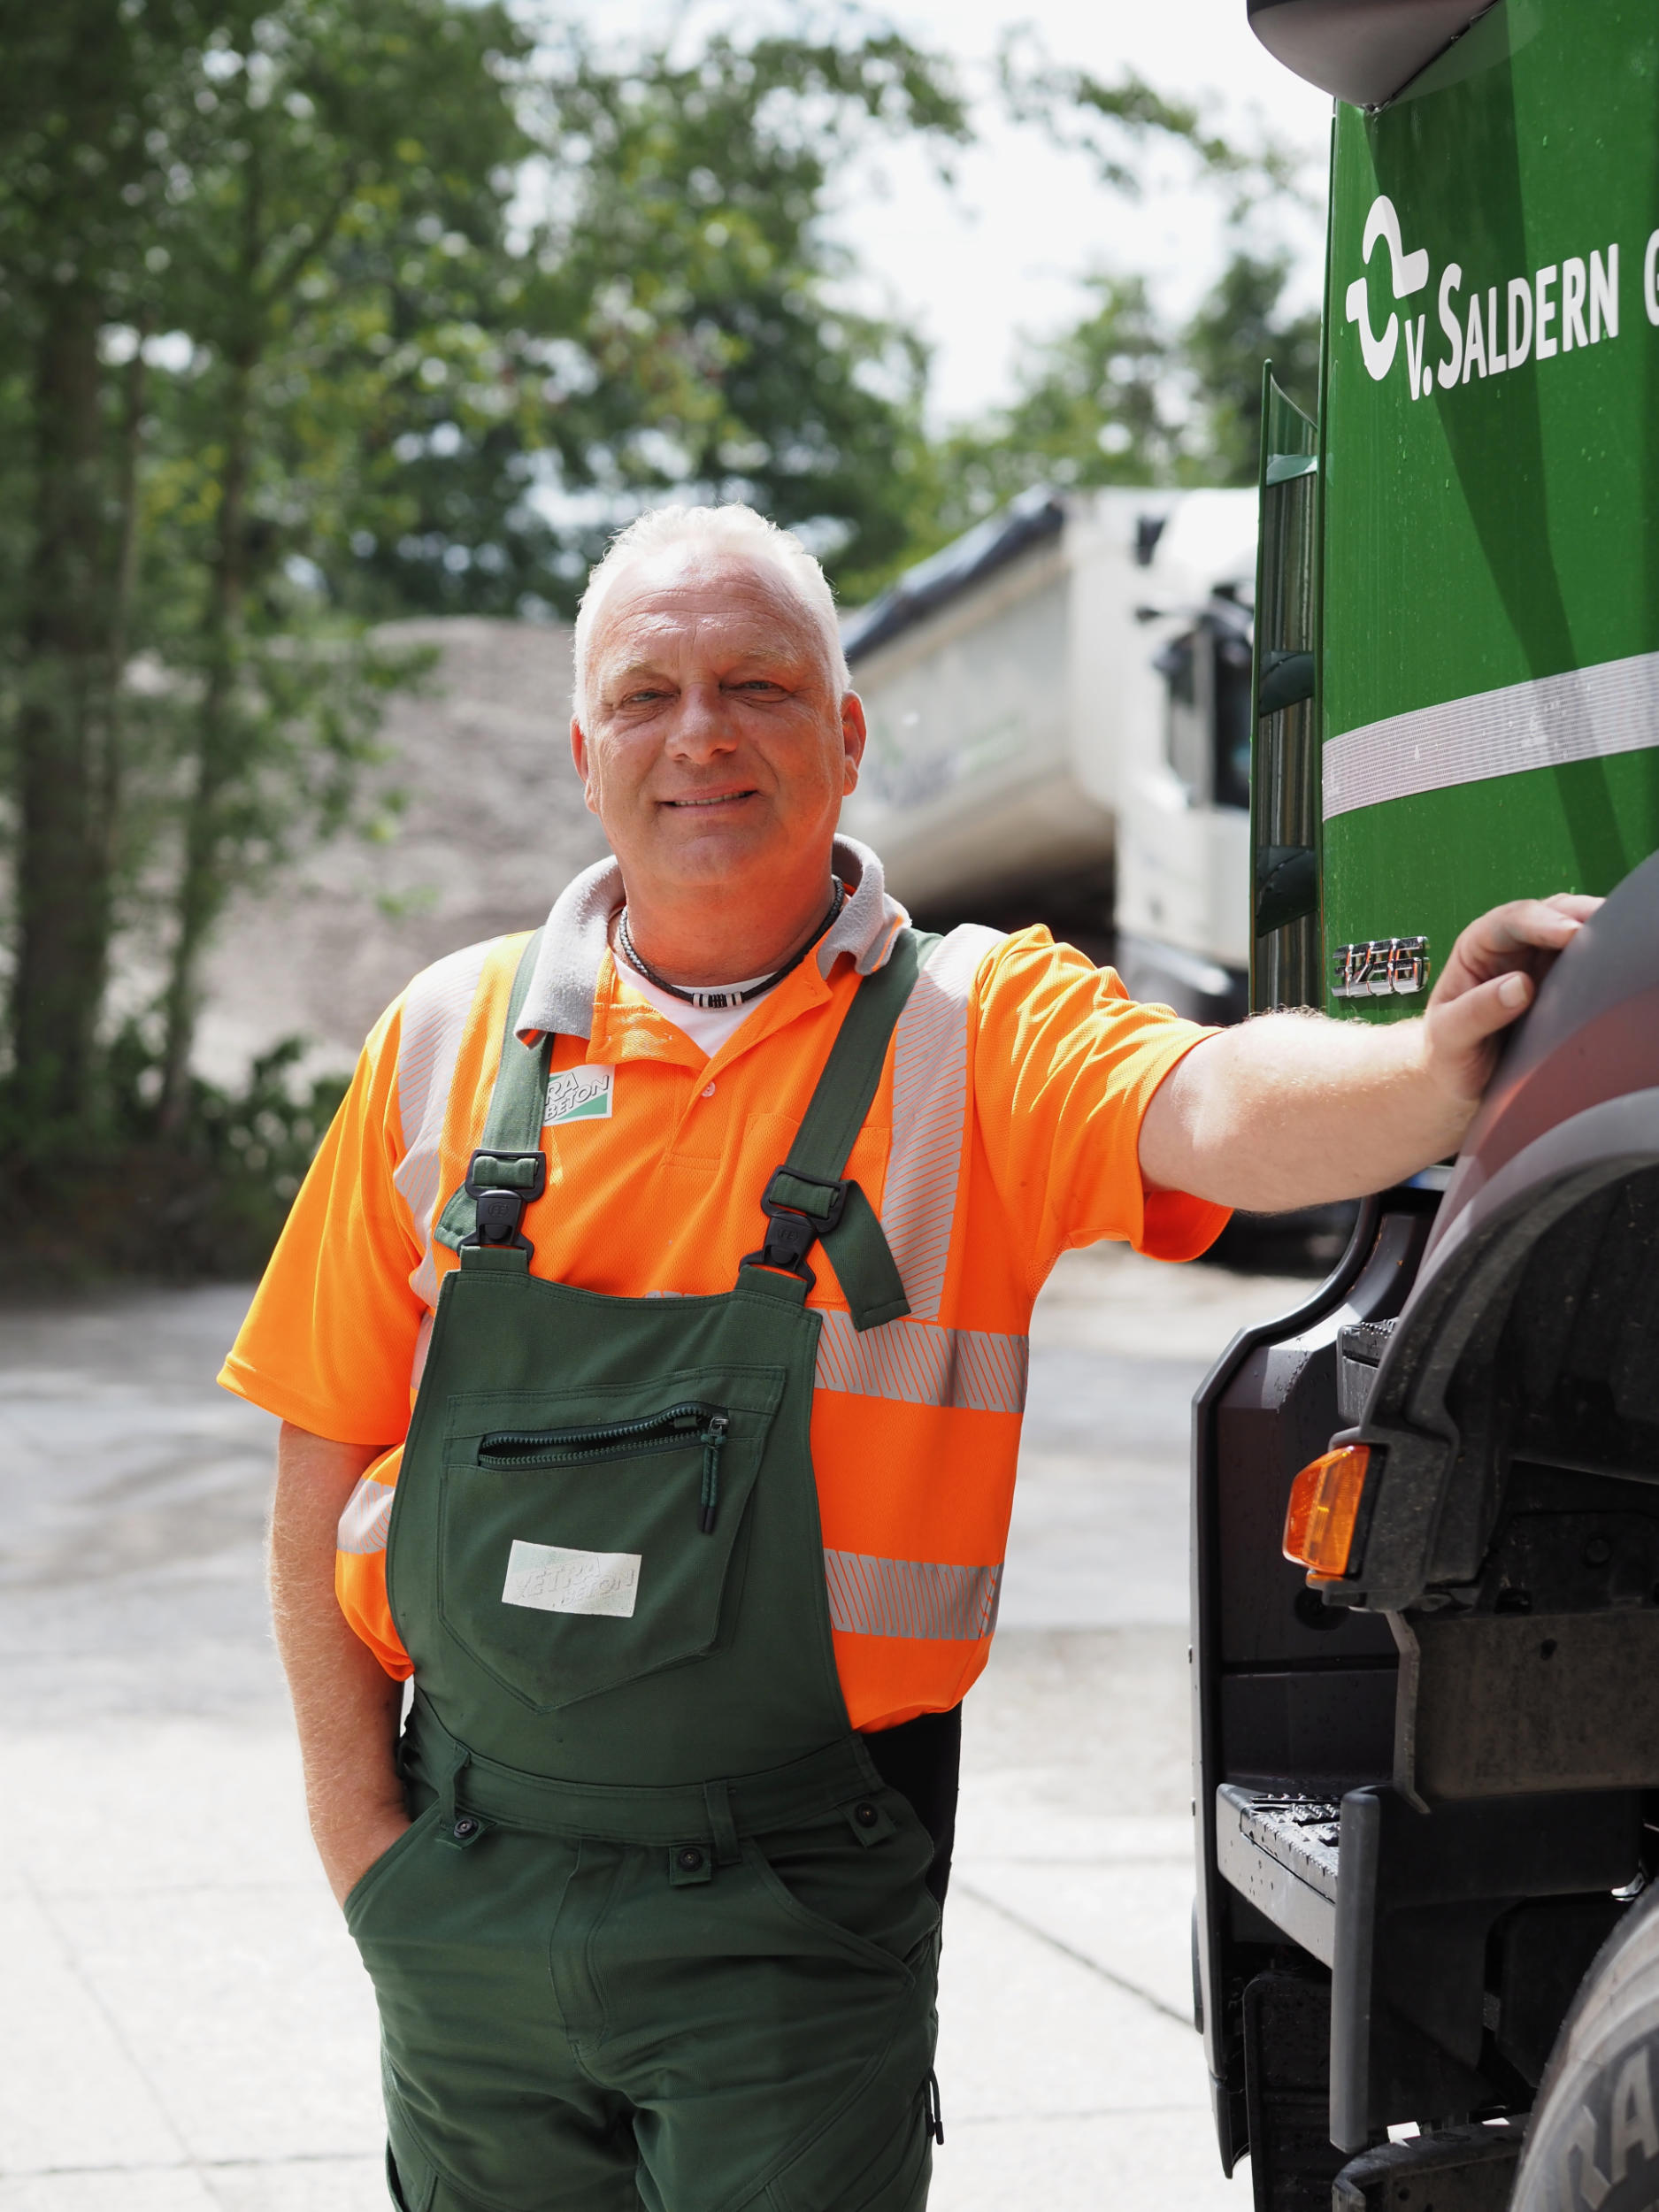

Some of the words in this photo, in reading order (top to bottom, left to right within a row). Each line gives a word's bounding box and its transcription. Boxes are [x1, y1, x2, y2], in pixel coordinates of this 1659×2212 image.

[1644, 228, 1659, 326] G
[544, 1075, 610, 1122] BETON
[545, 1072, 579, 1106] RA
